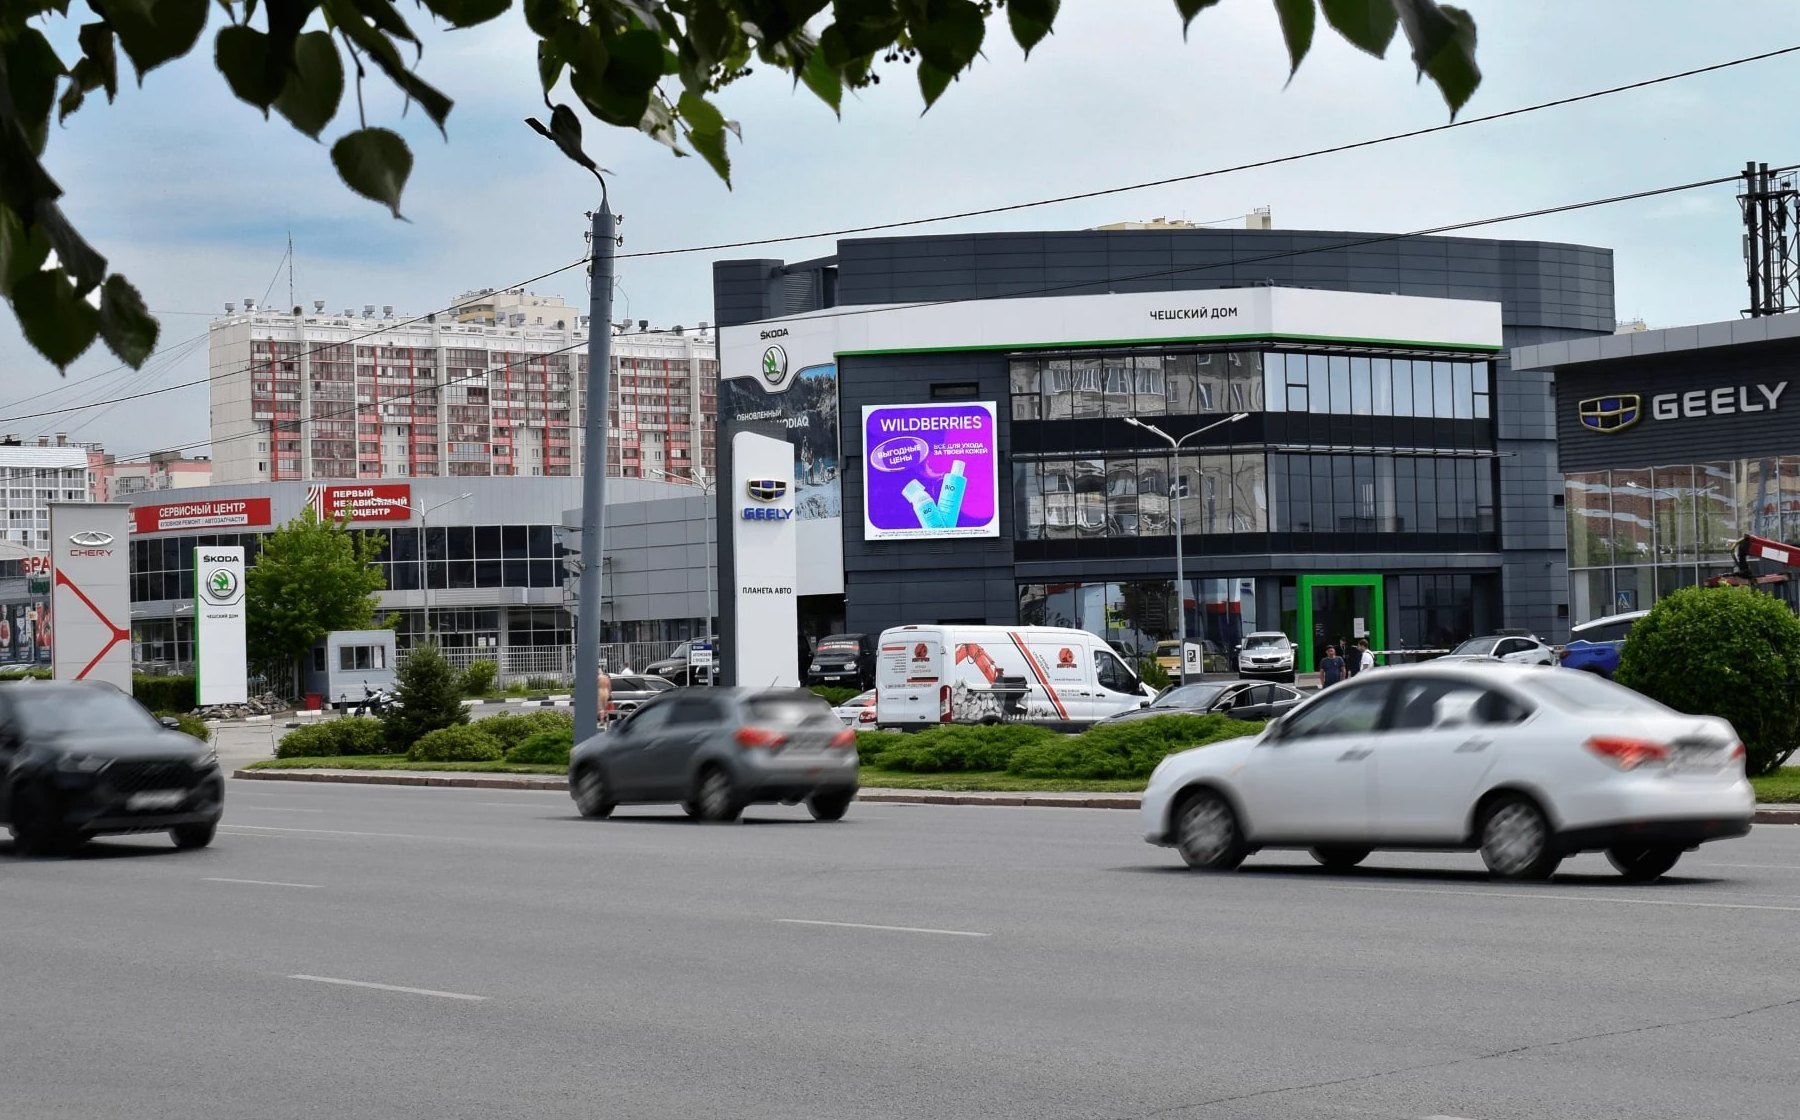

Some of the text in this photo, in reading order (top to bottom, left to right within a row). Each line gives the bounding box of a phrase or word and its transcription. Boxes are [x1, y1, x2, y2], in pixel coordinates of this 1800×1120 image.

[1150, 306, 1238, 320] ЧЕШСКИЙ ДОМ
[760, 328, 789, 340] ŠKODA
[1652, 381, 1788, 420] GEELY
[880, 415, 982, 432] WILDBERRIES
[877, 443, 921, 459] ВЫГОДНЫЕ
[889, 455, 913, 465] ЦЕНЫ
[333, 488, 374, 498] ПЕРВЫЙ
[159, 502, 246, 518] СЕРВИСНЫЙ ЦЕНТР
[741, 507, 794, 520] GEELY
[70, 549, 113, 557] CHERY
[203, 554, 239, 563] ŠKODA
[742, 587, 792, 595] ПЛАНЕТА АВТО
